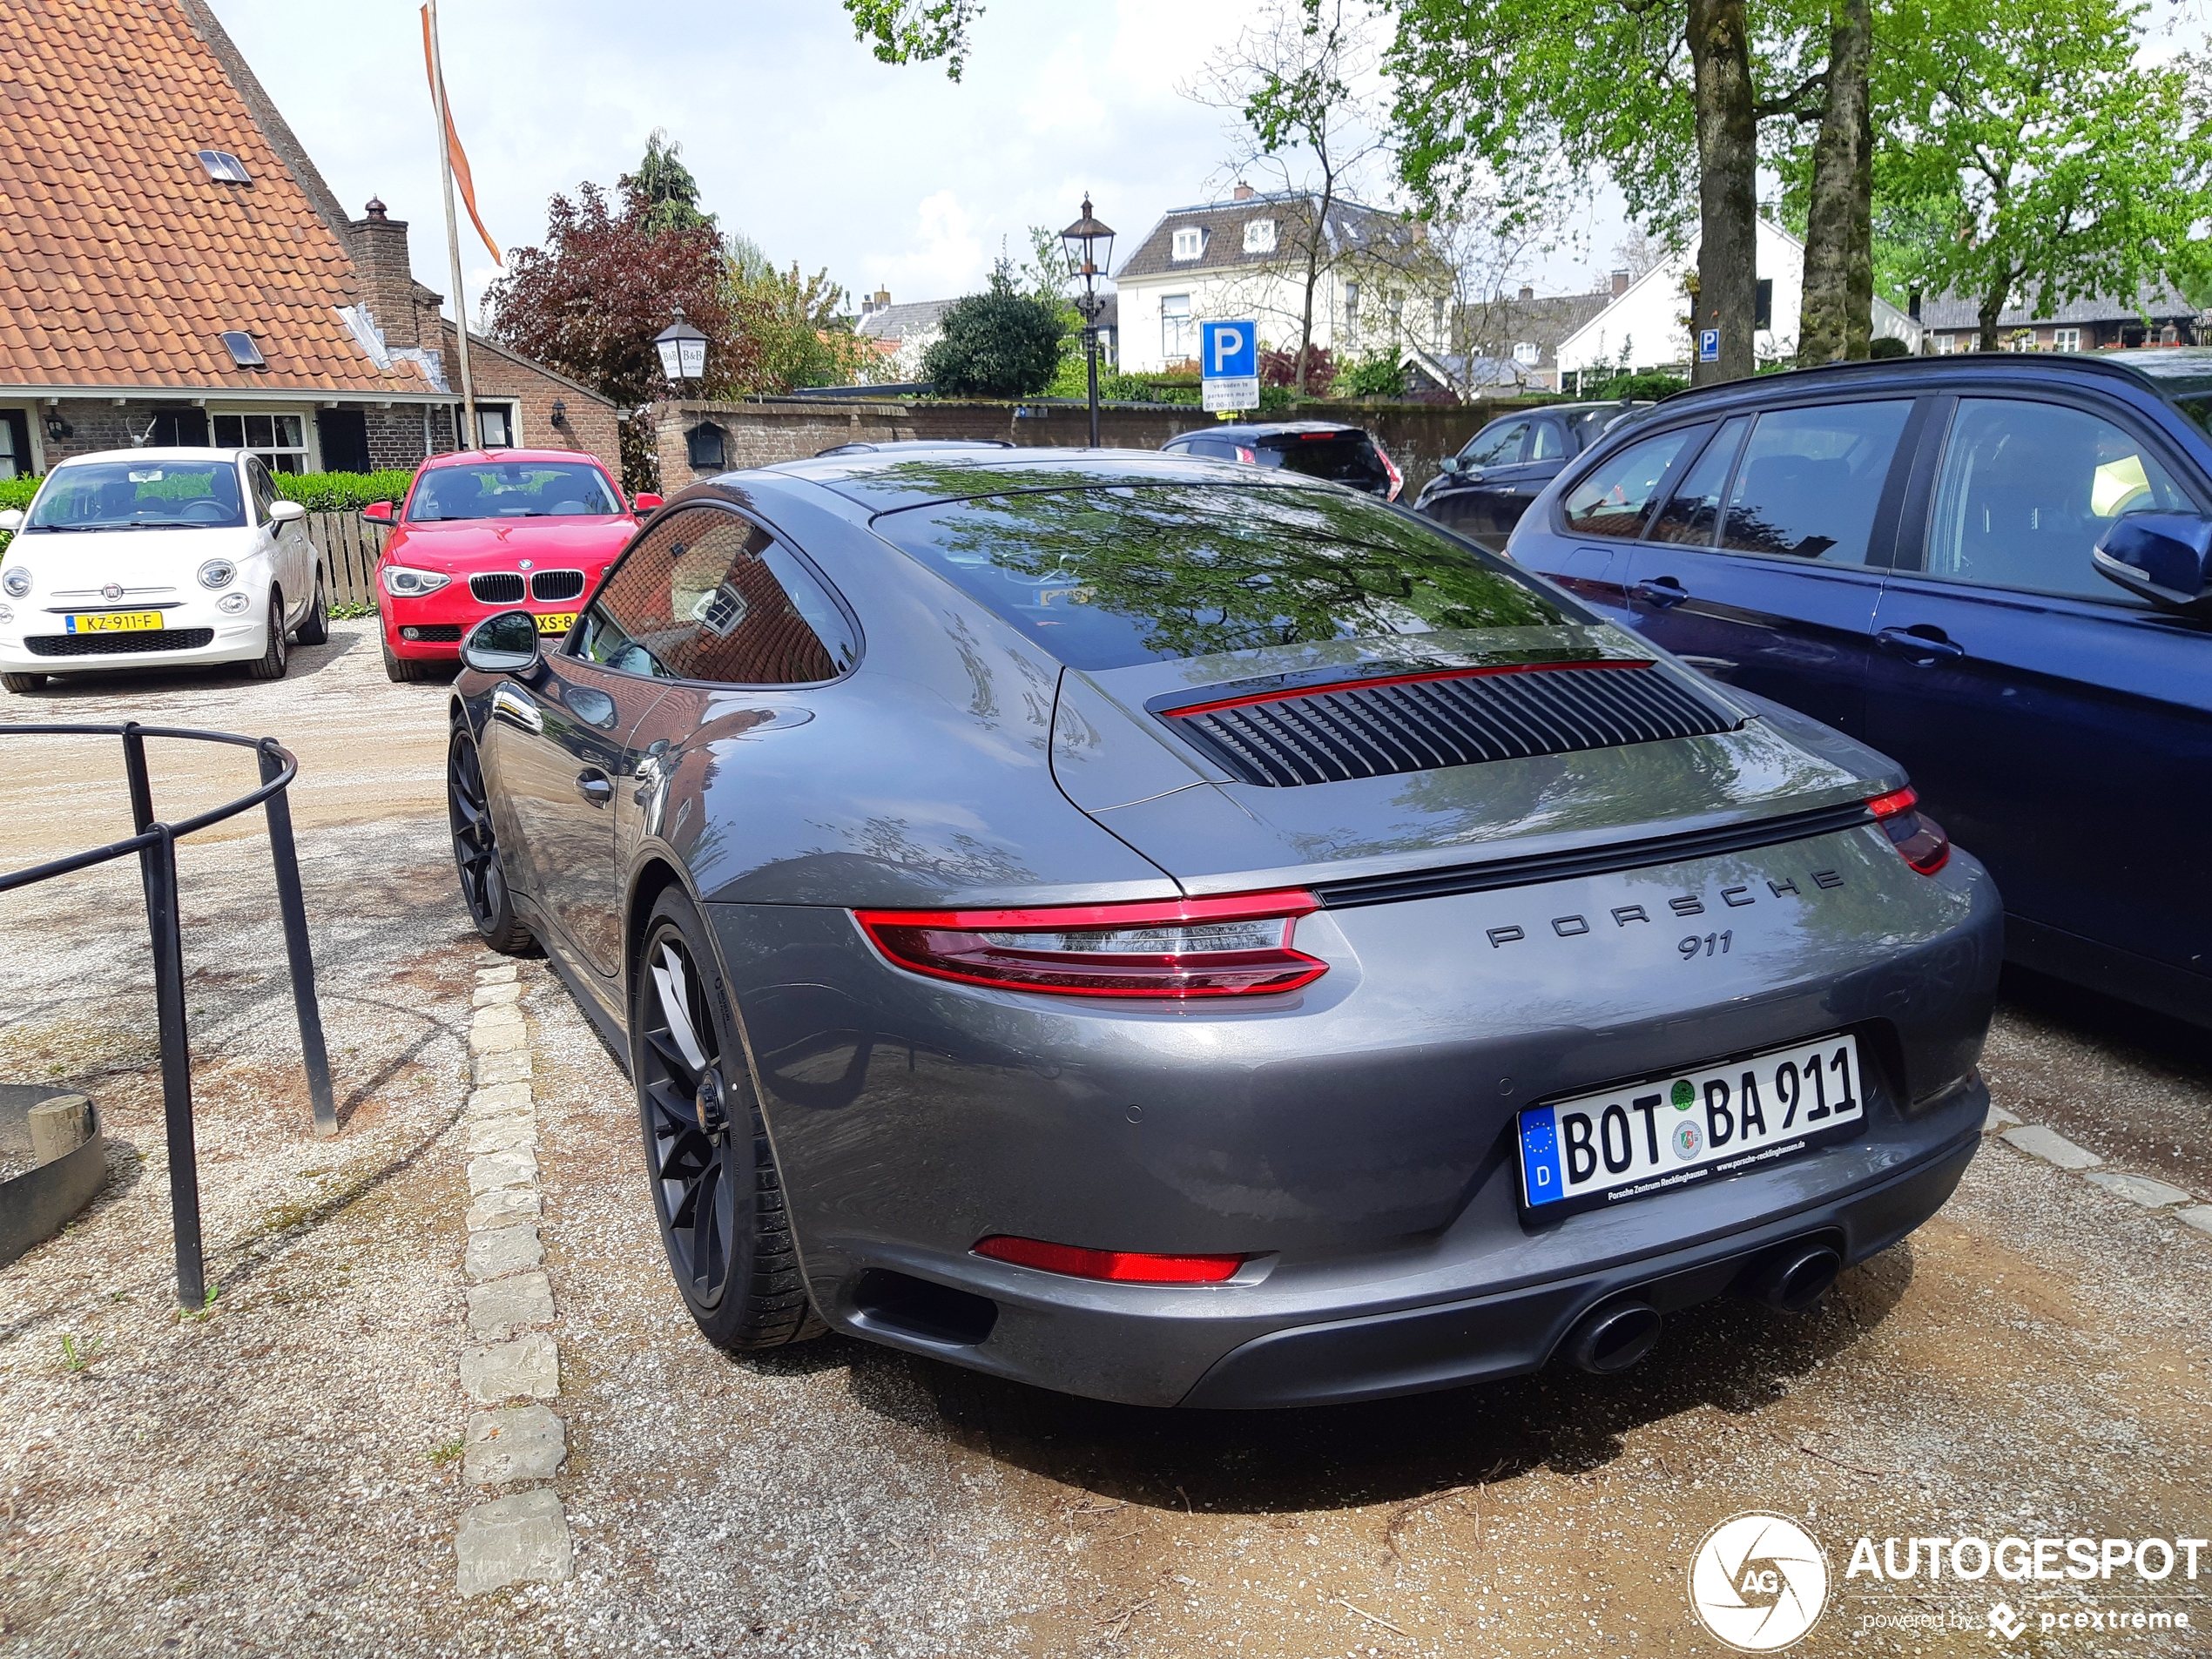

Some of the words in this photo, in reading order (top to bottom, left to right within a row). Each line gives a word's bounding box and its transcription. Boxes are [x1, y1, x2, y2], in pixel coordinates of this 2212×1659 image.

[1214, 327, 1243, 372] P
[1703, 333, 1716, 352] P
[663, 351, 678, 362] B&B
[683, 350, 702, 361] B&B
[86, 614, 152, 631] KZ-911-F
[538, 616, 572, 630] XS-8
[1487, 870, 1844, 948] PORSCHE
[1678, 929, 1733, 961] 911
[1561, 1093, 1662, 1185] BOT
[1703, 1070, 1767, 1149] BA
[1775, 1046, 1857, 1130] 911
[1537, 1165, 1550, 1187] D
[1608, 1187, 1634, 1201] Porsche
[1634, 1182, 1661, 1195] Zentrum
[1661, 1168, 1708, 1188] Recklinghausen
[1716, 1140, 1805, 1172] www.porsche-recklinghausen.de
